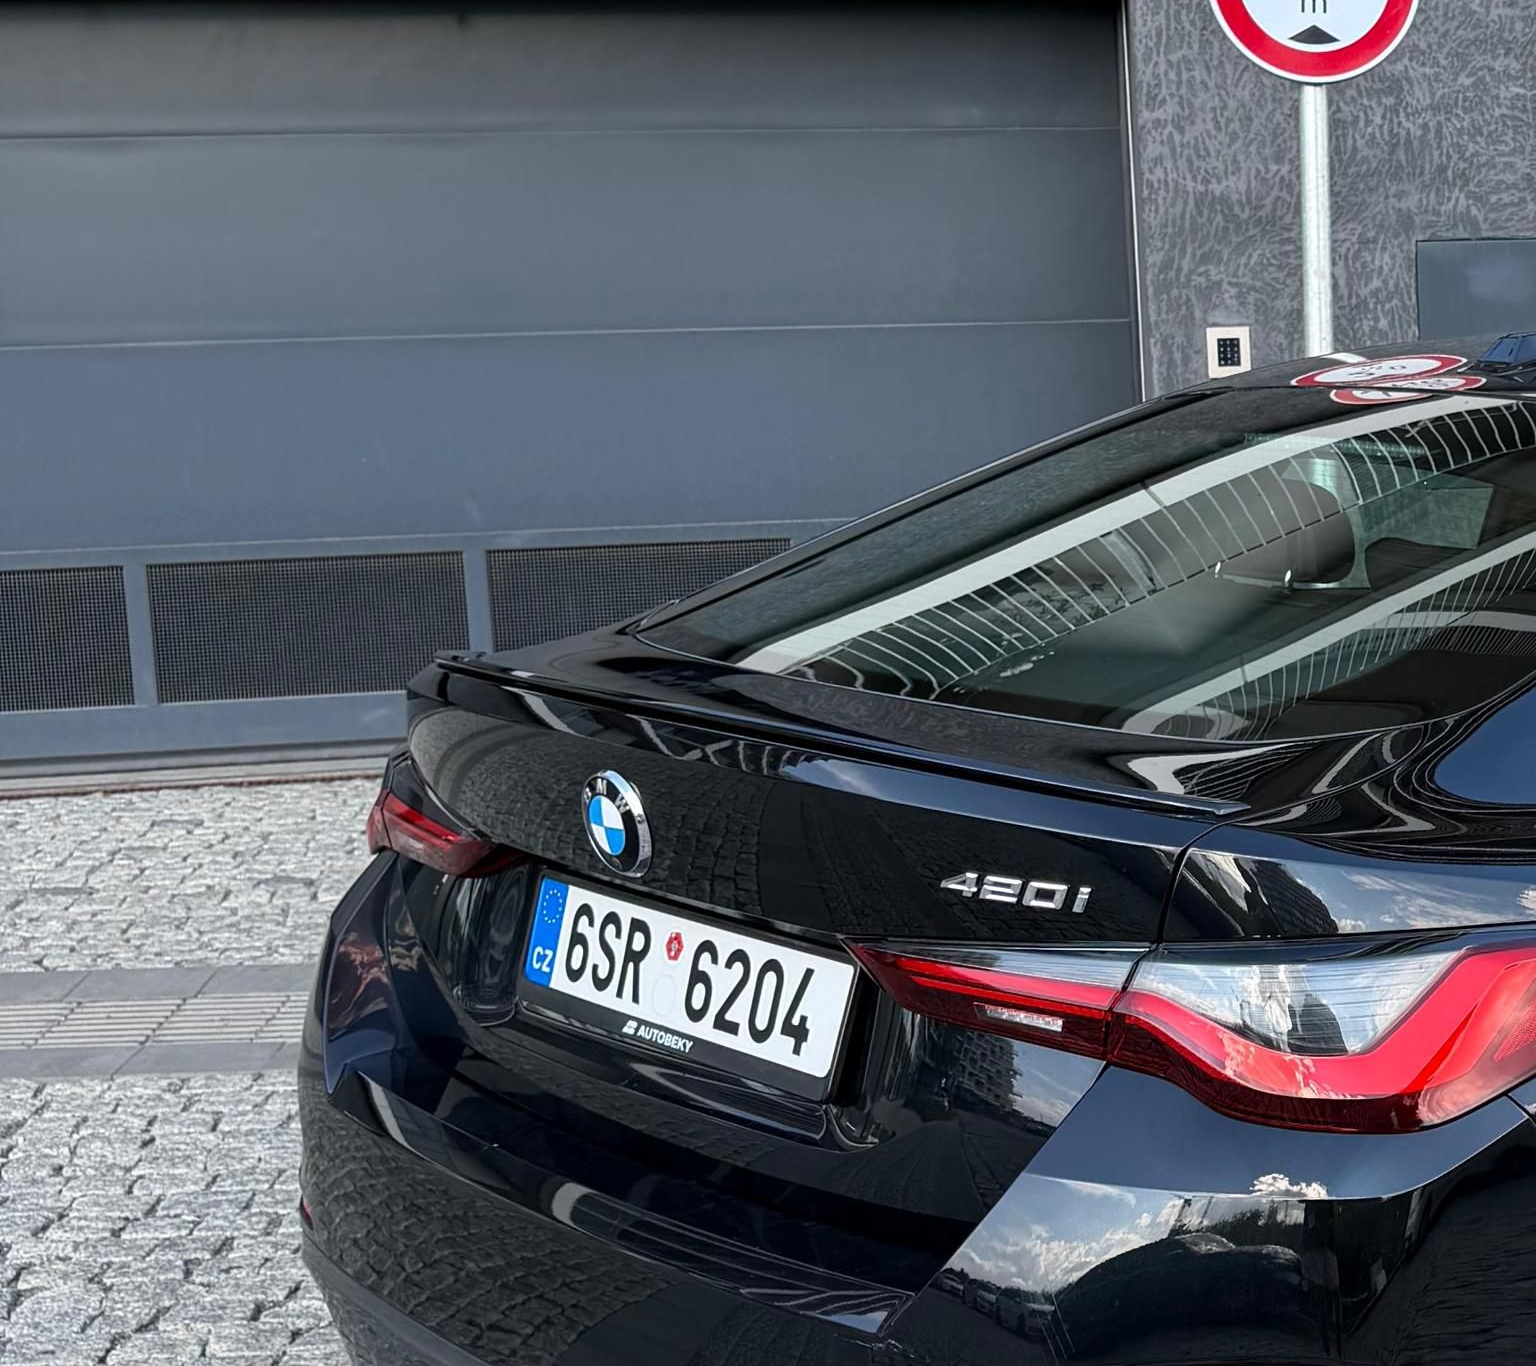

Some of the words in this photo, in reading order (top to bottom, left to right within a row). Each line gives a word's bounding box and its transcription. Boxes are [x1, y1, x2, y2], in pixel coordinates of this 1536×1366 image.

[584, 777, 631, 815] BMW
[940, 871, 1093, 914] 420i
[532, 946, 554, 973] CZ
[564, 902, 652, 1006] 6SR
[684, 939, 816, 1057] 6204
[636, 1024, 694, 1054] AUTOBEKY
